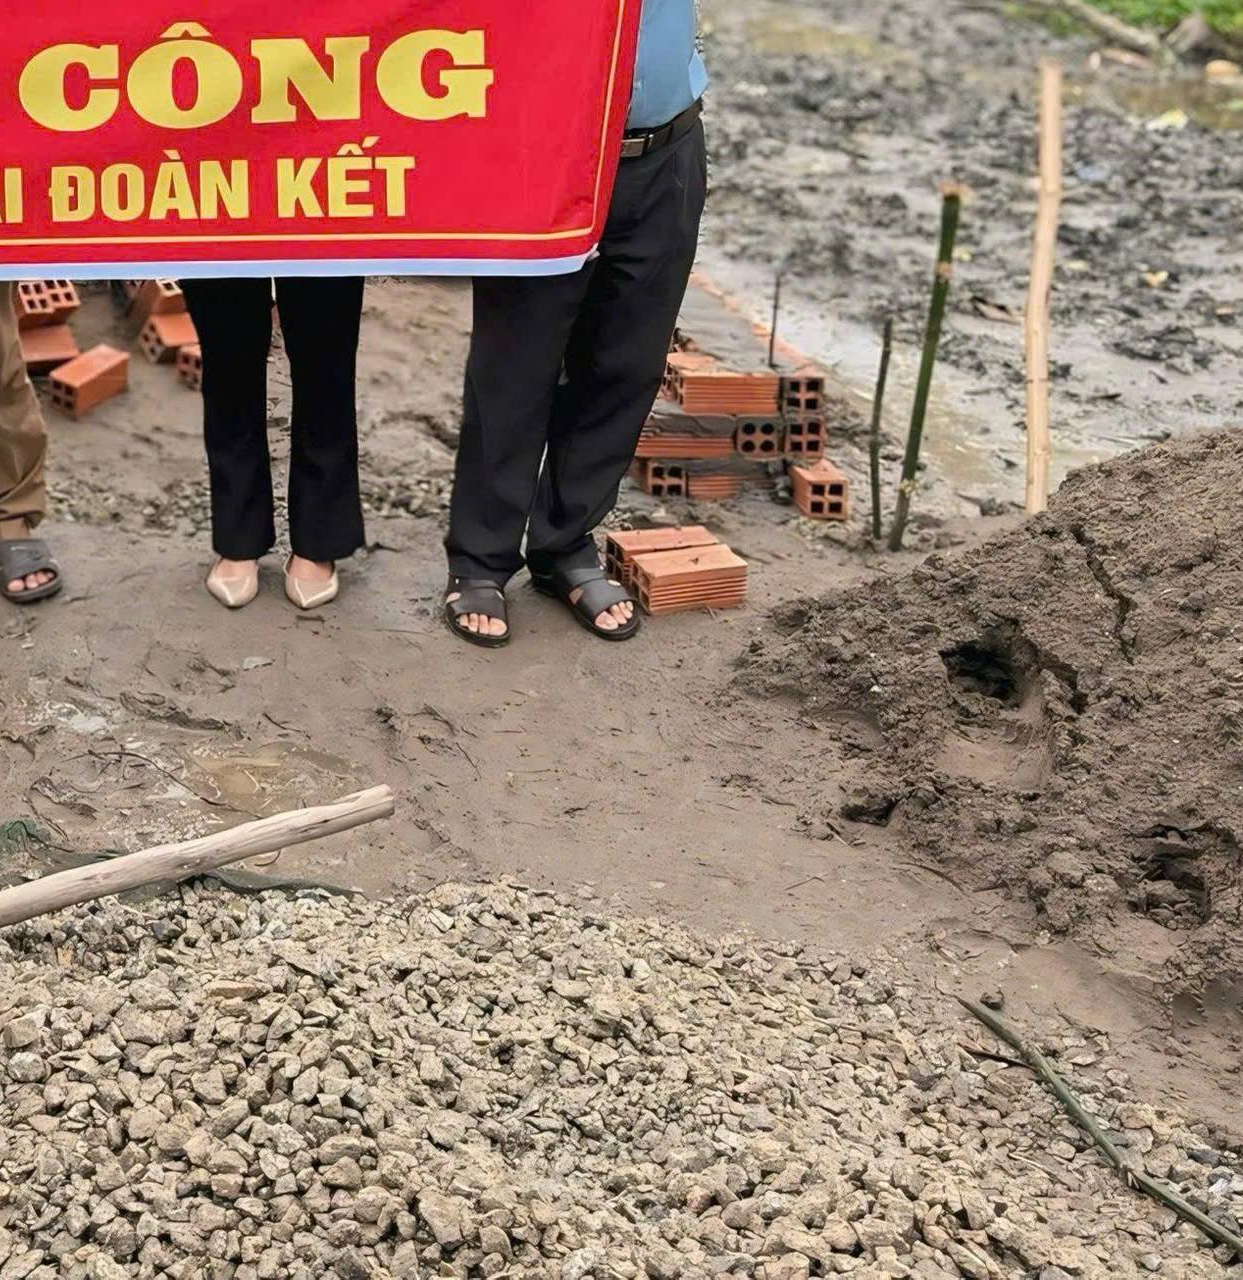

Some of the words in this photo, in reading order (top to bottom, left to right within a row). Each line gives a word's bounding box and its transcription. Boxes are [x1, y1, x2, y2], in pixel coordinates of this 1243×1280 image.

[17, 22, 496, 134] CÔNG
[48, 149, 251, 224] ĐOÀN
[276, 135, 417, 220] KẾT
